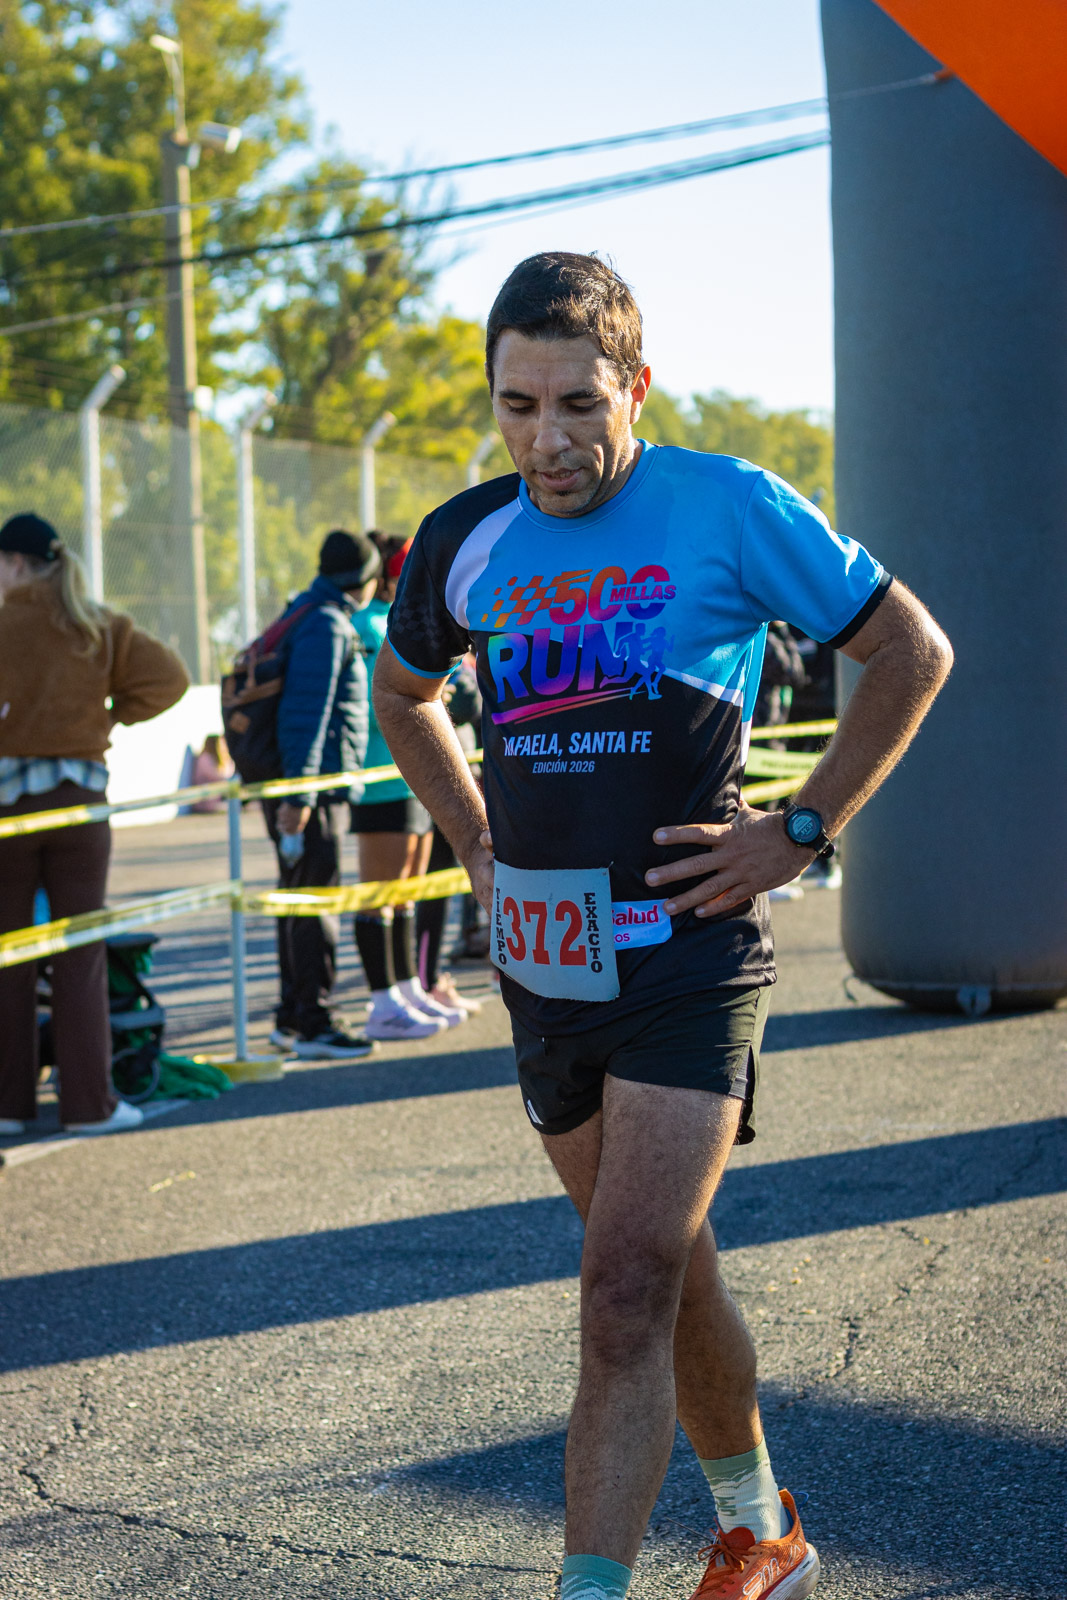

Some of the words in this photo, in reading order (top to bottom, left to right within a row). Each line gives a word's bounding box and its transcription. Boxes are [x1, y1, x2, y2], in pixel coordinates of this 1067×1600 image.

[549, 565, 670, 625] 500
[609, 584, 677, 603] MILLAS
[487, 621, 634, 704] RUN
[532, 758, 568, 774] EDICIÓN
[569, 760, 596, 773] 2026
[568, 731, 626, 754] SANTA
[630, 731, 653, 753] FE
[495, 887, 508, 965] TIEMPO
[503, 896, 588, 966] 372
[583, 892, 603, 974] EXACTO
[611, 904, 659, 926] alud
